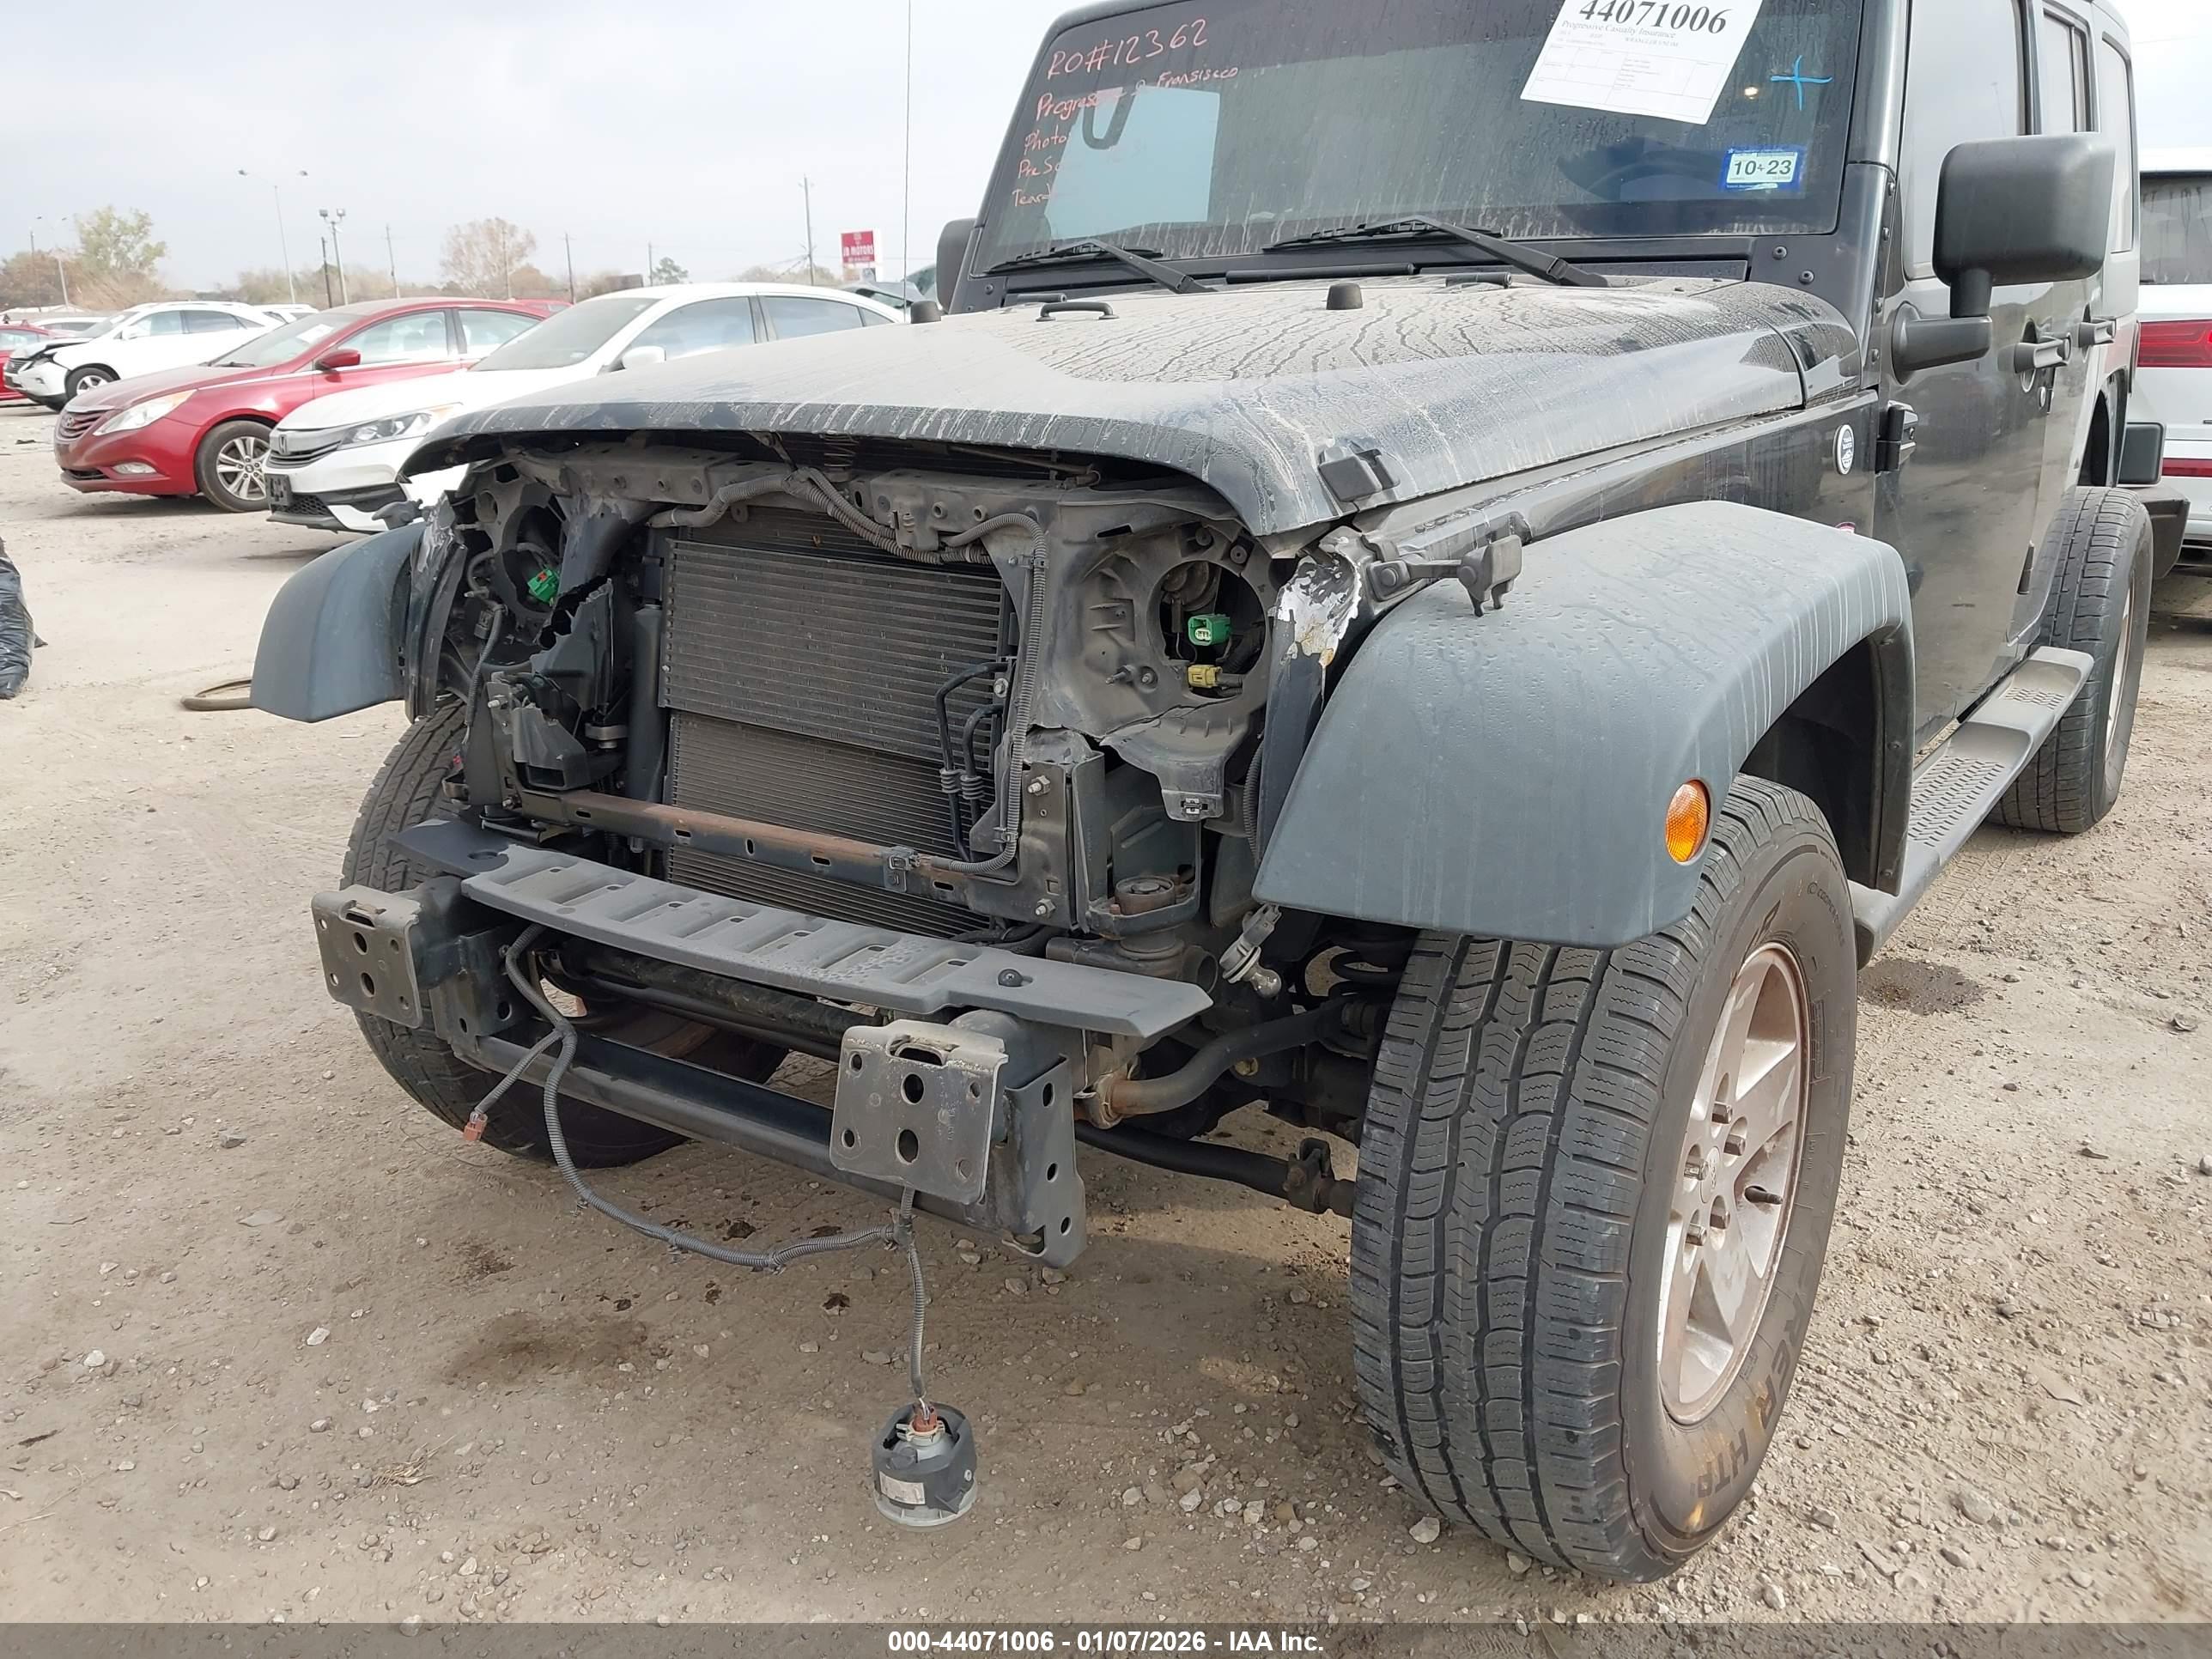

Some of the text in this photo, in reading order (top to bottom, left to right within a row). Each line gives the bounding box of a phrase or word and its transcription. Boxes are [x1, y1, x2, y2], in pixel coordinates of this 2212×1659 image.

[1561, 21, 1676, 39] Progressive Casualty Insurance
[1579, 0, 1734, 34] 44071006
